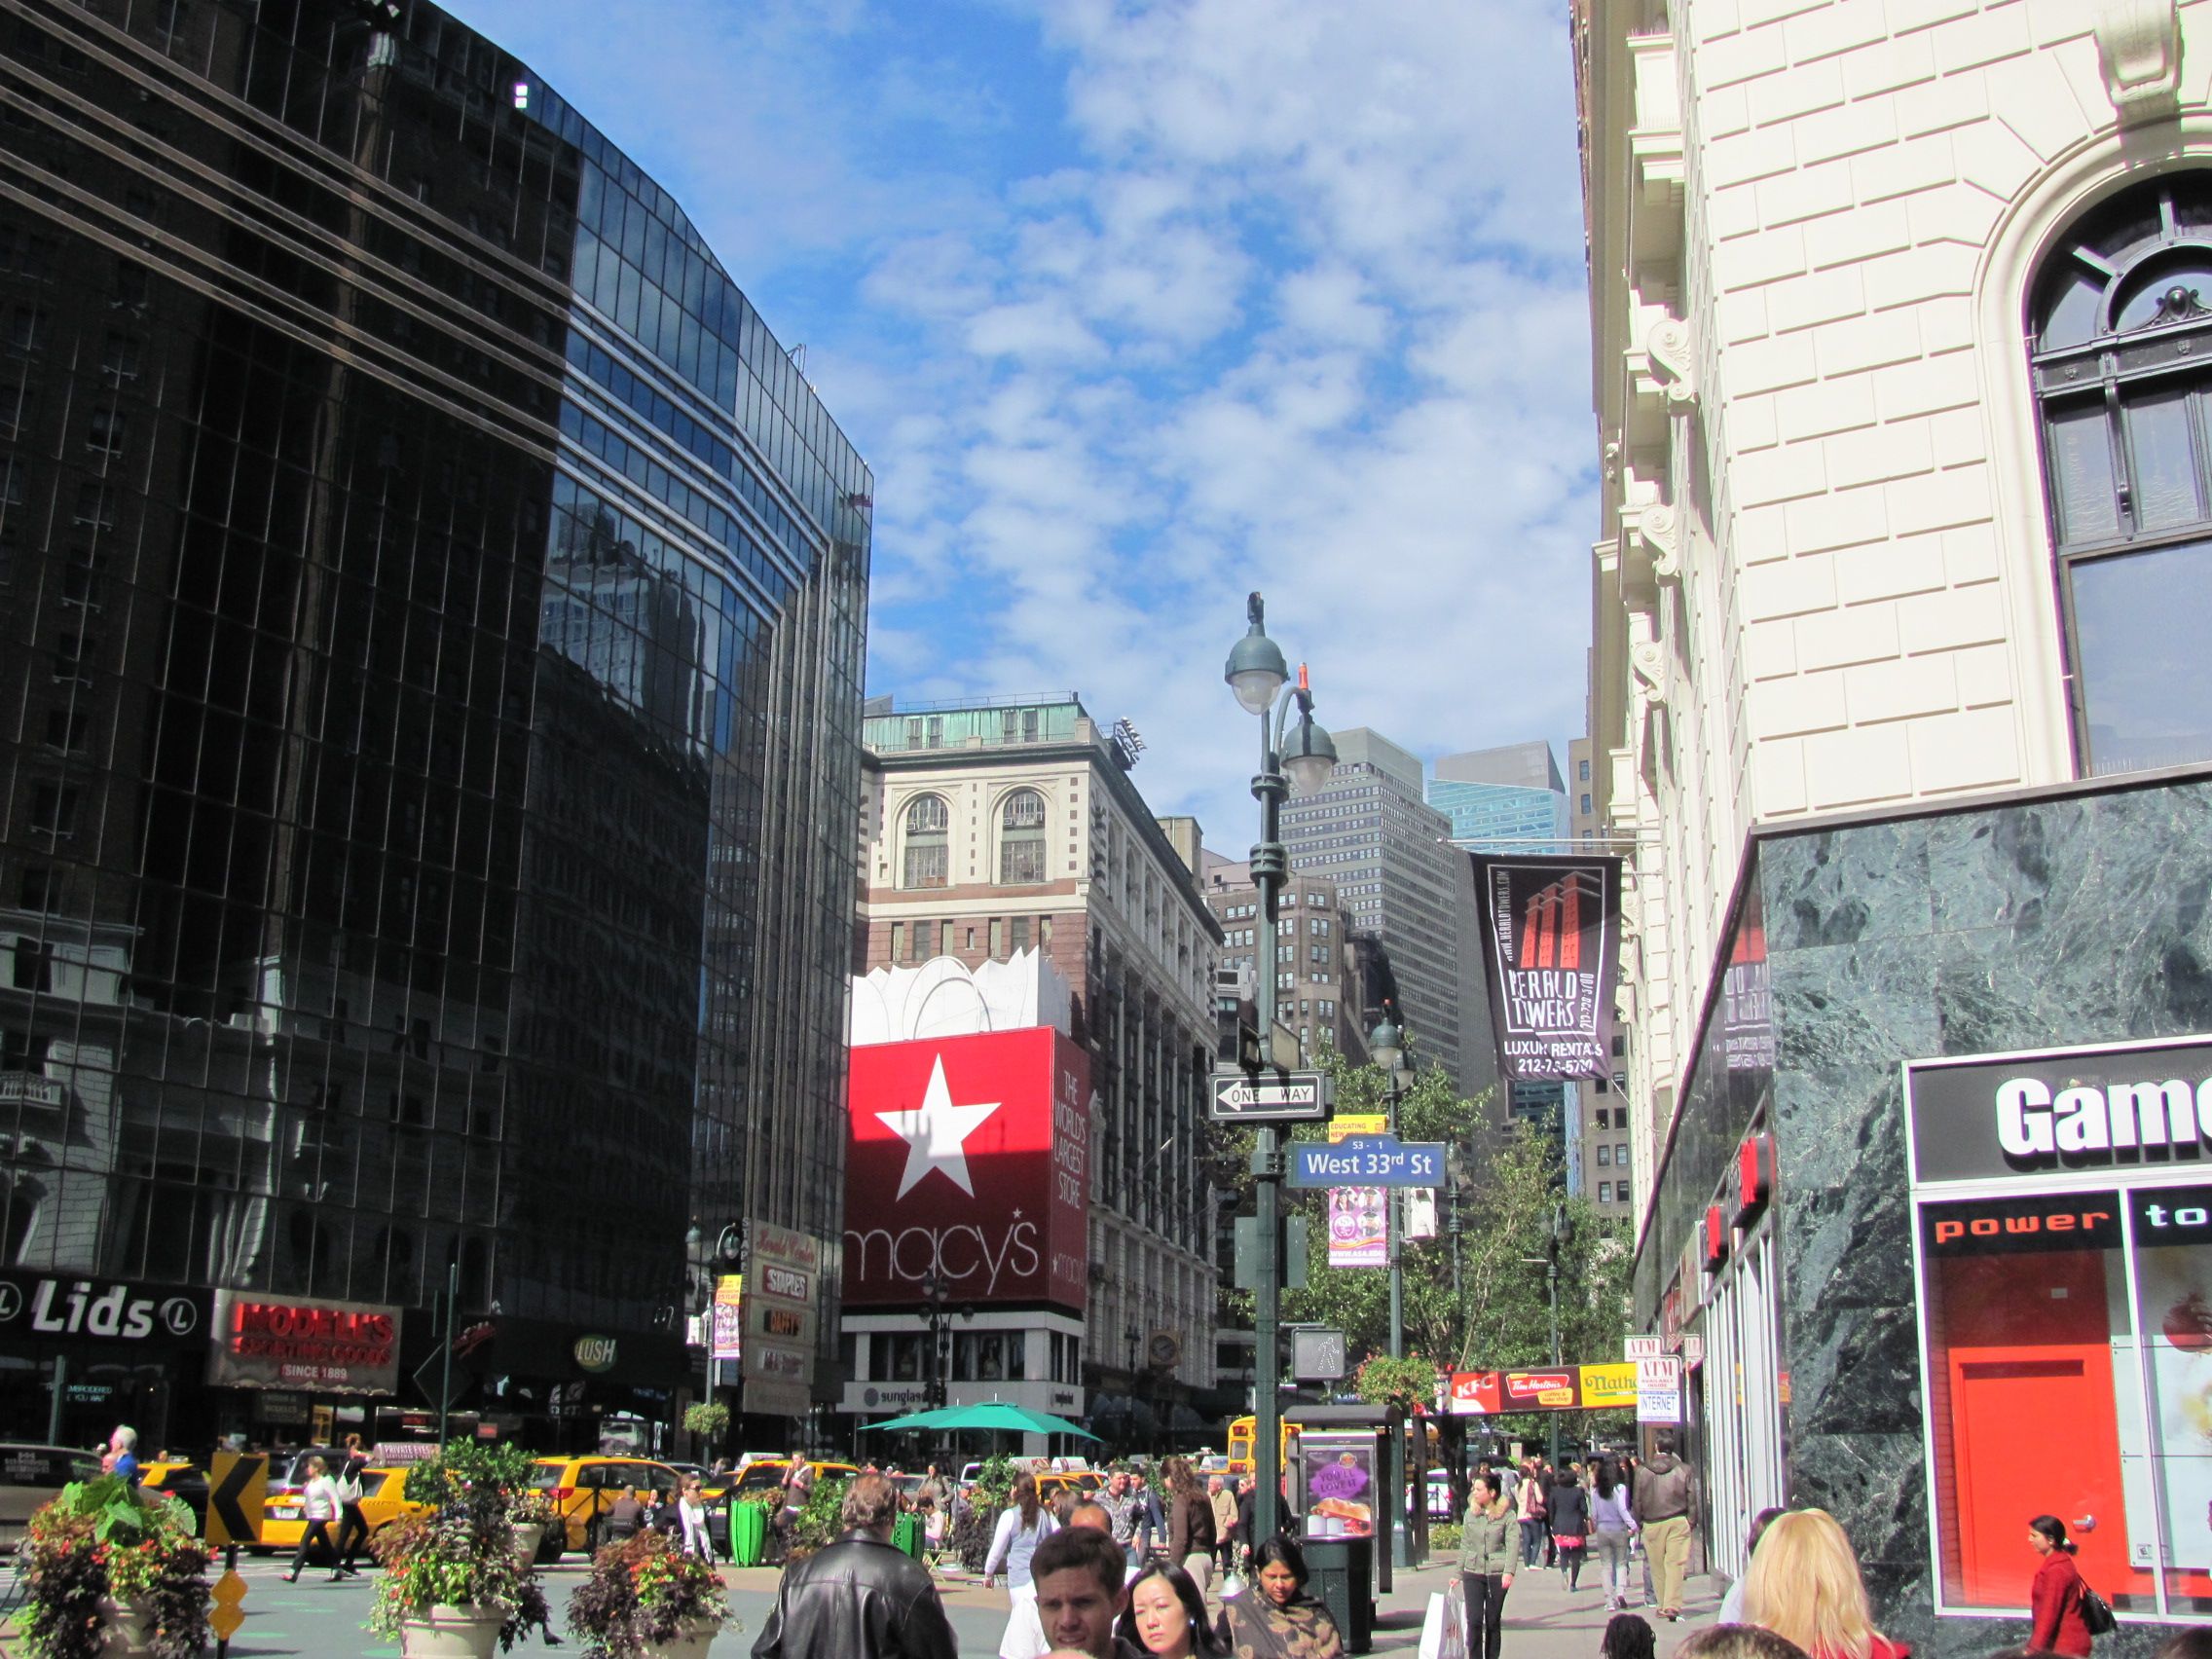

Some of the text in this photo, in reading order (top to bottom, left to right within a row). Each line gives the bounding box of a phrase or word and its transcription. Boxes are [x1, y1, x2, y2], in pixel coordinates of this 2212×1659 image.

[1552, 1043, 1604, 1057] RENTAS
[1063, 1070, 1078, 1106] THE
[1232, 1088, 1310, 1103] ONE WAY
[1054, 1099, 1087, 1145] WORLD'S
[1053, 1133, 1085, 1176] LARGEST
[1352, 1141, 1363, 1150] 53
[1307, 1152, 1432, 1175] West 33rd St
[1058, 1171, 1080, 1210] STORE
[1936, 1204, 2207, 1244] power to
[843, 1208, 1039, 1296] macy's
[767, 1269, 807, 1299] STAPLES
[32, 1280, 154, 1338] Lids
[235, 1303, 394, 1345] MODELL'S
[576, 1340, 617, 1363] LUSH
[1630, 1340, 1655, 1353] ATM
[283, 1365, 348, 1380] SINCE 1889
[1643, 1360, 1673, 1376] ATM
[1456, 1375, 1494, 1398] KFC
[1511, 1380, 1563, 1390] Tim Hortons
[1641, 1396, 1676, 1410] INTERNET
[1319, 1469, 1355, 1482] YOU'LL
[1320, 1482, 1346, 1493] LOVE
